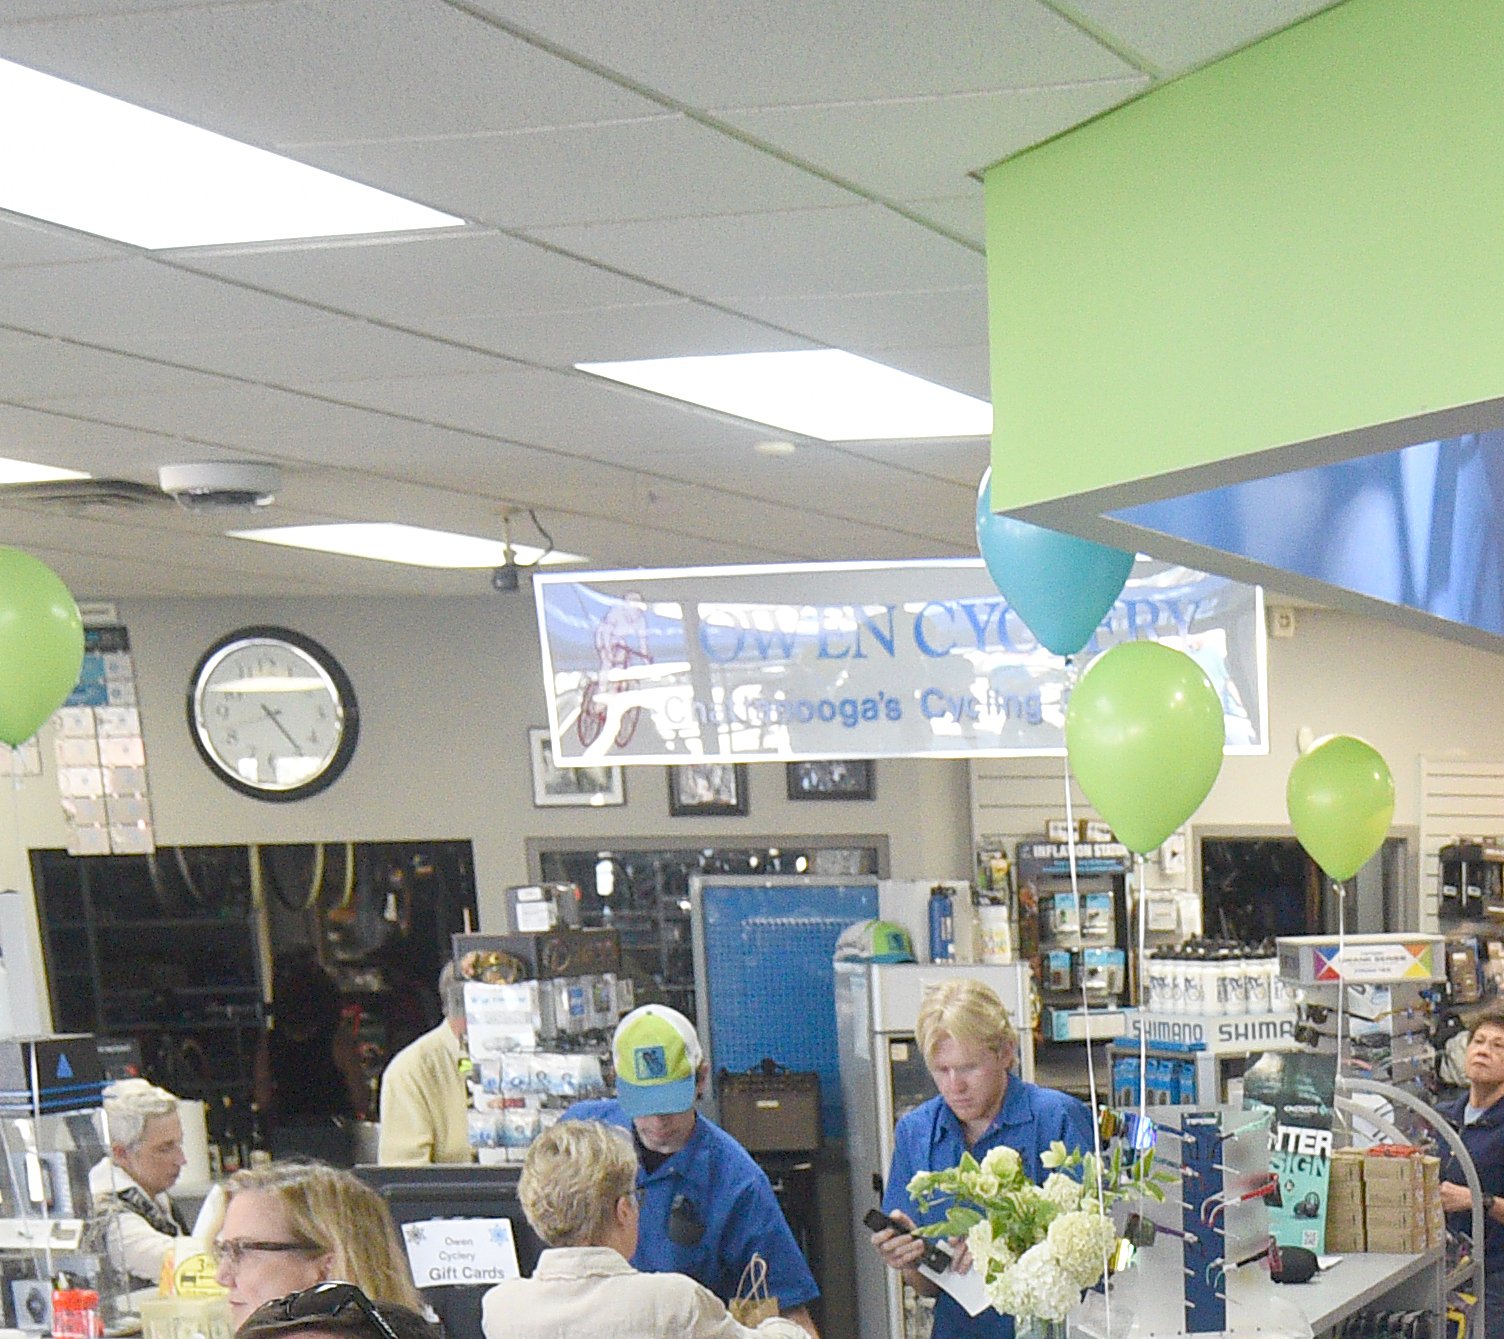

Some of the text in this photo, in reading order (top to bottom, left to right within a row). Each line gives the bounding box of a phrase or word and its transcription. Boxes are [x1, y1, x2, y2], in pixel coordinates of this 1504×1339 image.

[1132, 1021, 1204, 1041] SHIMANO
[444, 1237, 473, 1246] Owen
[438, 1250, 476, 1262] Cyclery
[428, 1265, 505, 1280] Gift Cards
